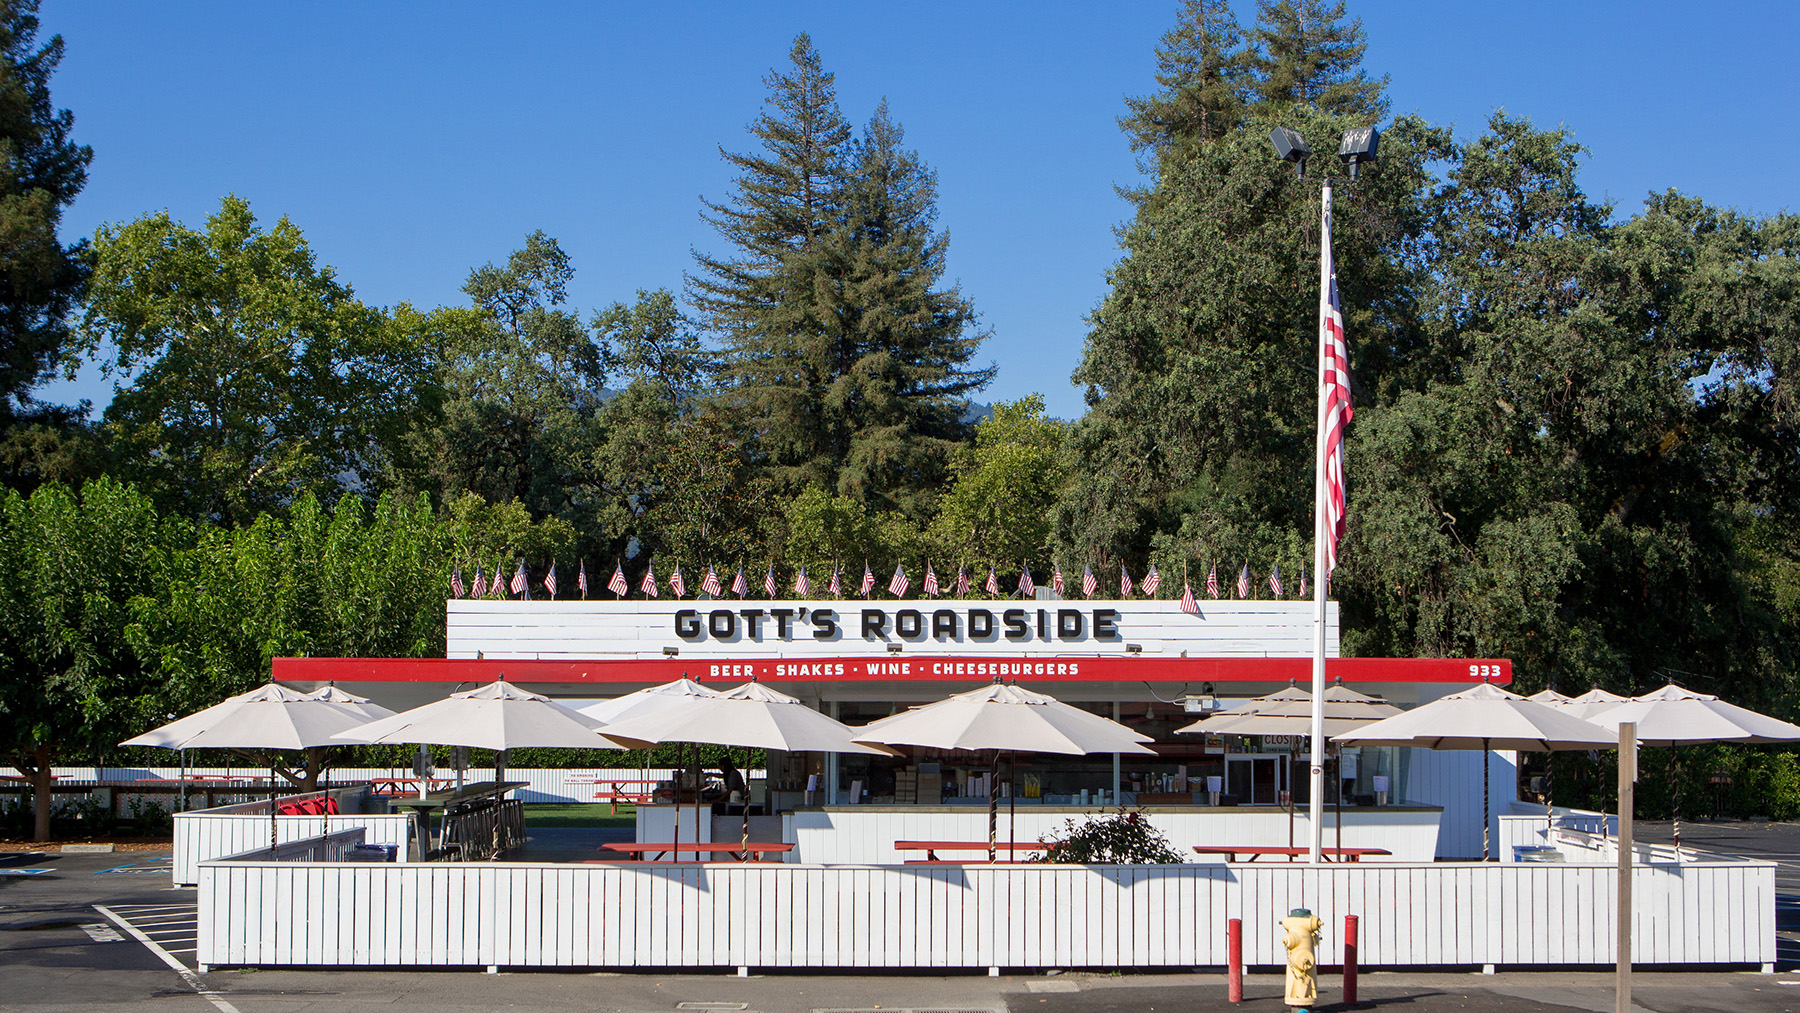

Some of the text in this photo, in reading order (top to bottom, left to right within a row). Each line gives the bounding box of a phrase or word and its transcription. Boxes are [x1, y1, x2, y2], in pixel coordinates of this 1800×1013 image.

[675, 608, 1118, 638] GOTT'S ROADSIDE
[710, 663, 1079, 677] BEER SHAKES WINE CHEESEBURGERS
[1469, 664, 1501, 677] 933
